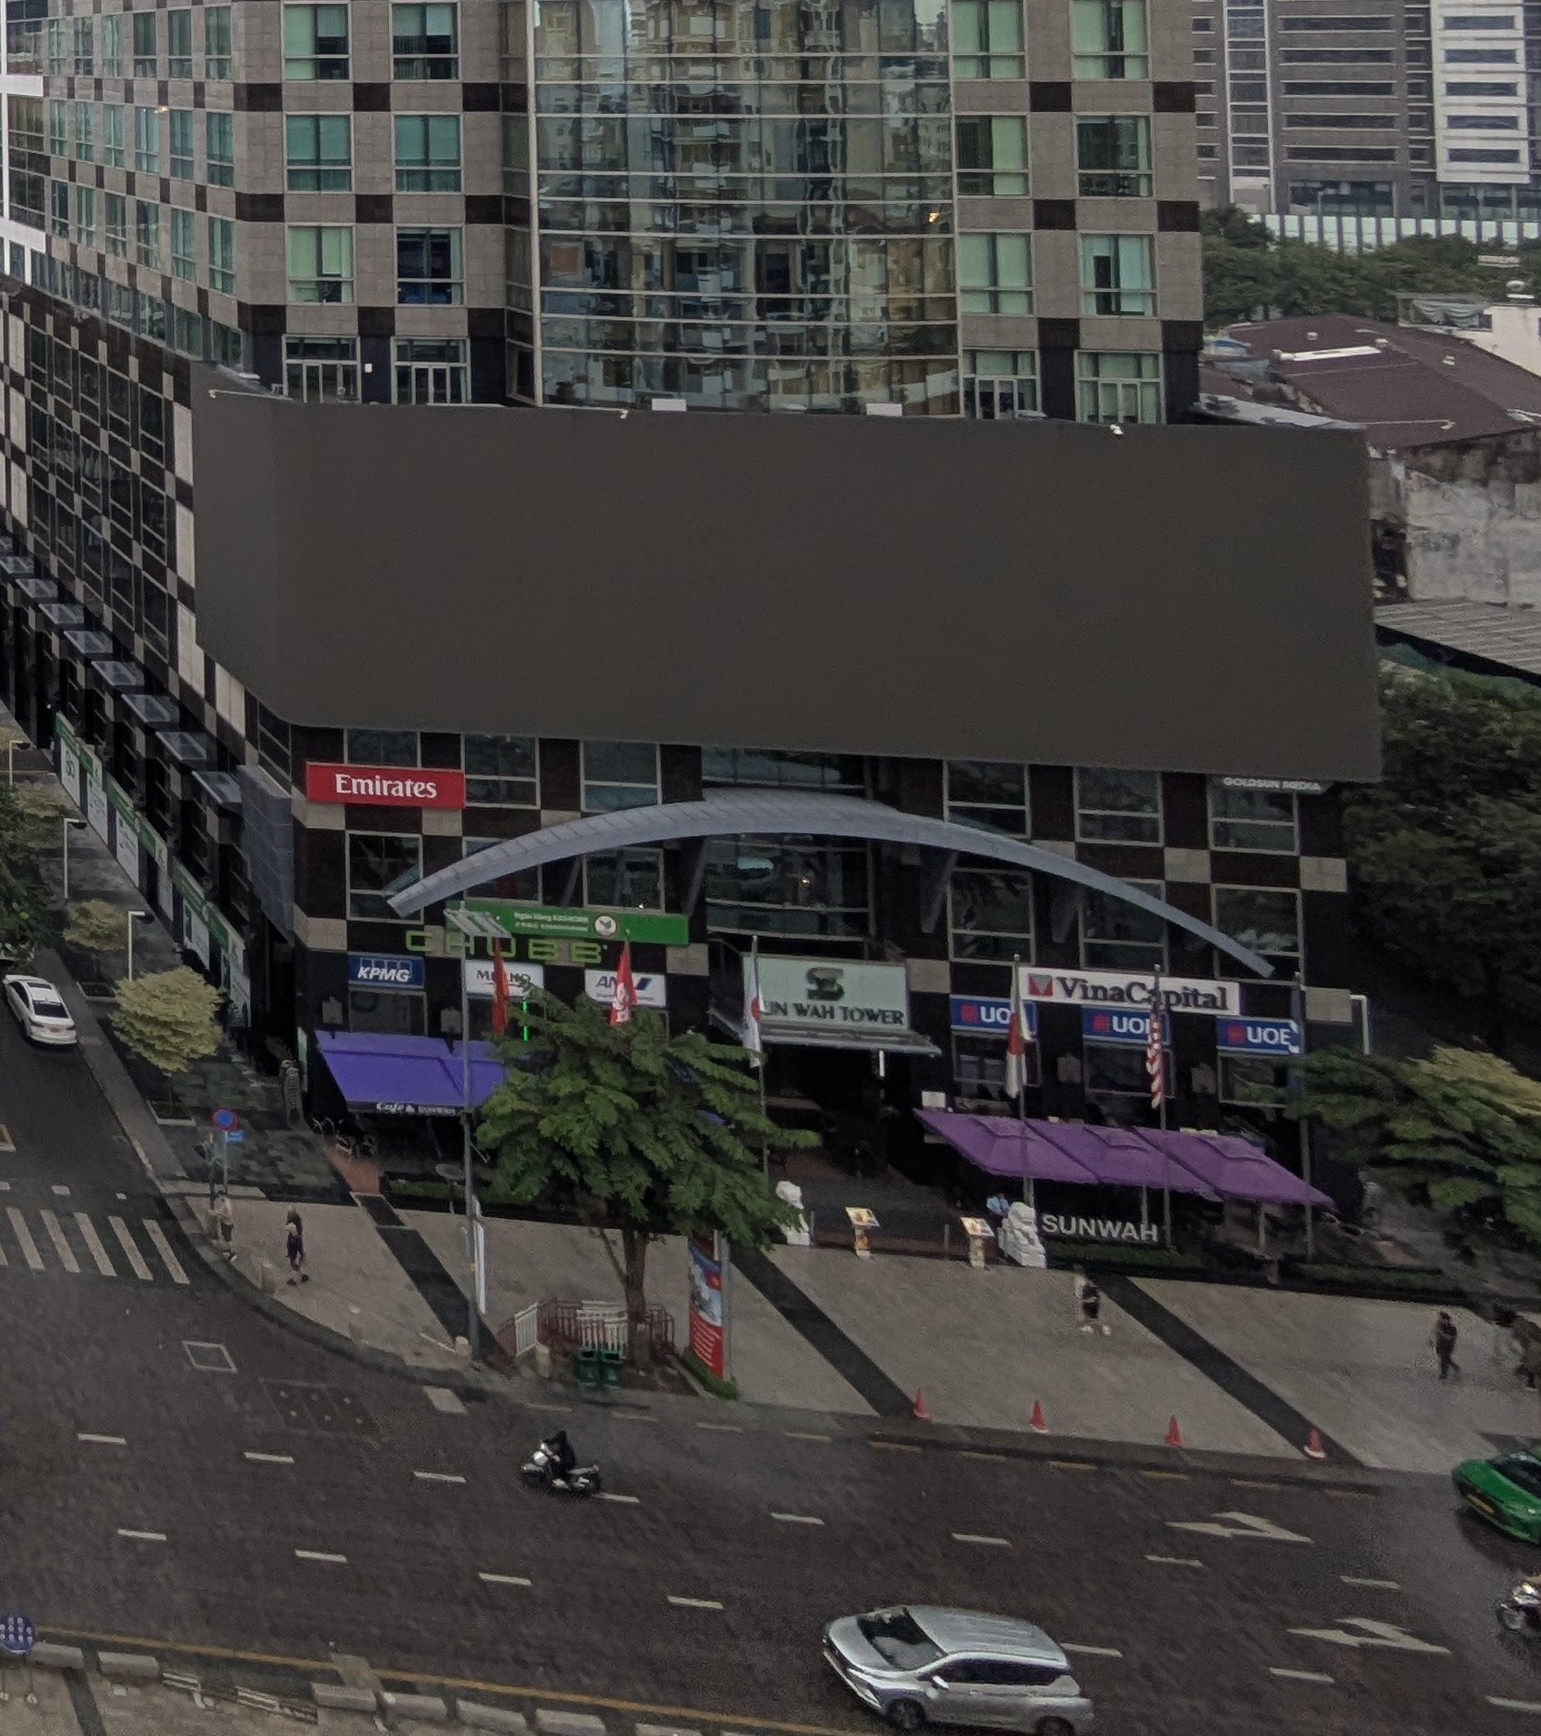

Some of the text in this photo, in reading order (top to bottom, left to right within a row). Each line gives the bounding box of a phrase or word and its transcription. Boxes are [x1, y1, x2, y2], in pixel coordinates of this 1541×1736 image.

[335, 773, 437, 799] Emirates
[405, 930, 600, 964] CHUBB
[358, 966, 411, 983] KPMG
[793, 1002, 835, 1020] WAH
[839, 1006, 904, 1025] TOWER
[980, 1006, 1011, 1024] UO
[1041, 1213, 1158, 1243] SUNWAH
